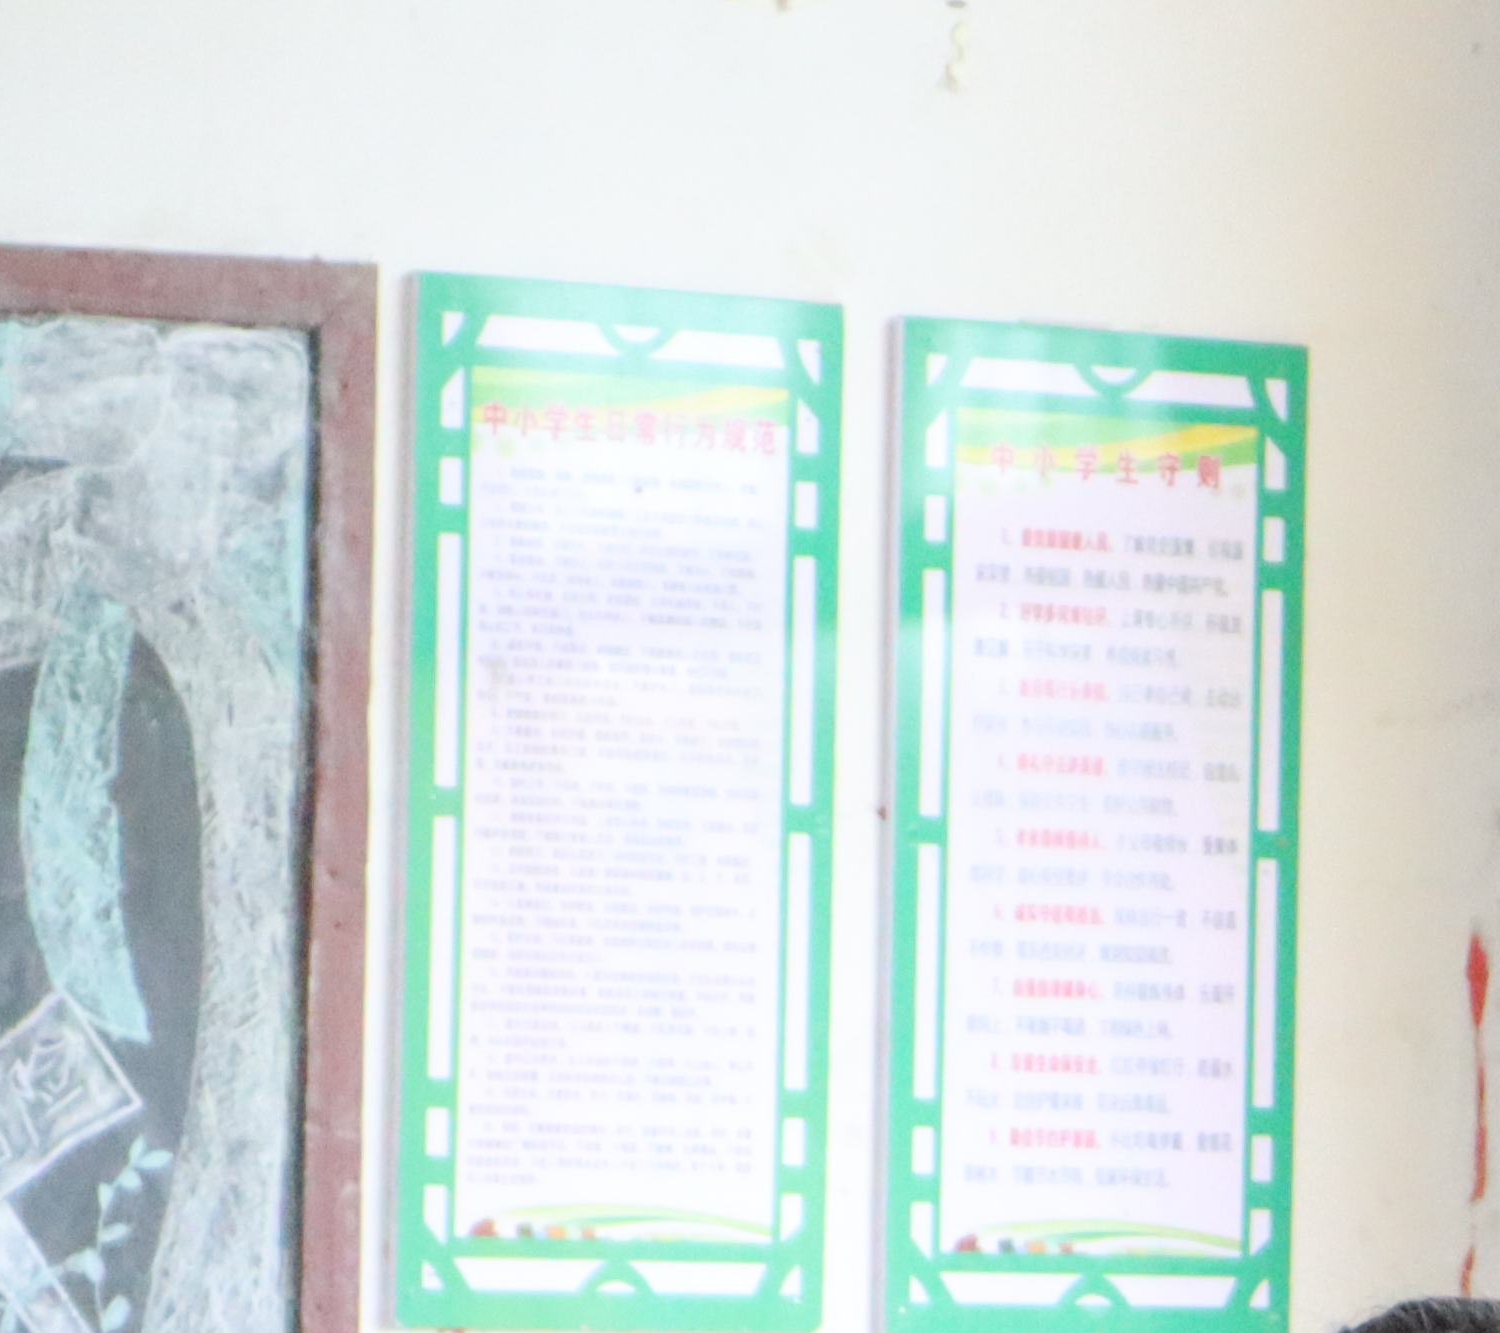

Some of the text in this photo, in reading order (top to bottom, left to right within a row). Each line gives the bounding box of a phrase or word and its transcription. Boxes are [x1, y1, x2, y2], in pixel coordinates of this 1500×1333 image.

[482, 400, 778, 456] 中小学生日常行为规范
[991, 442, 1222, 490] 中小学生守则
